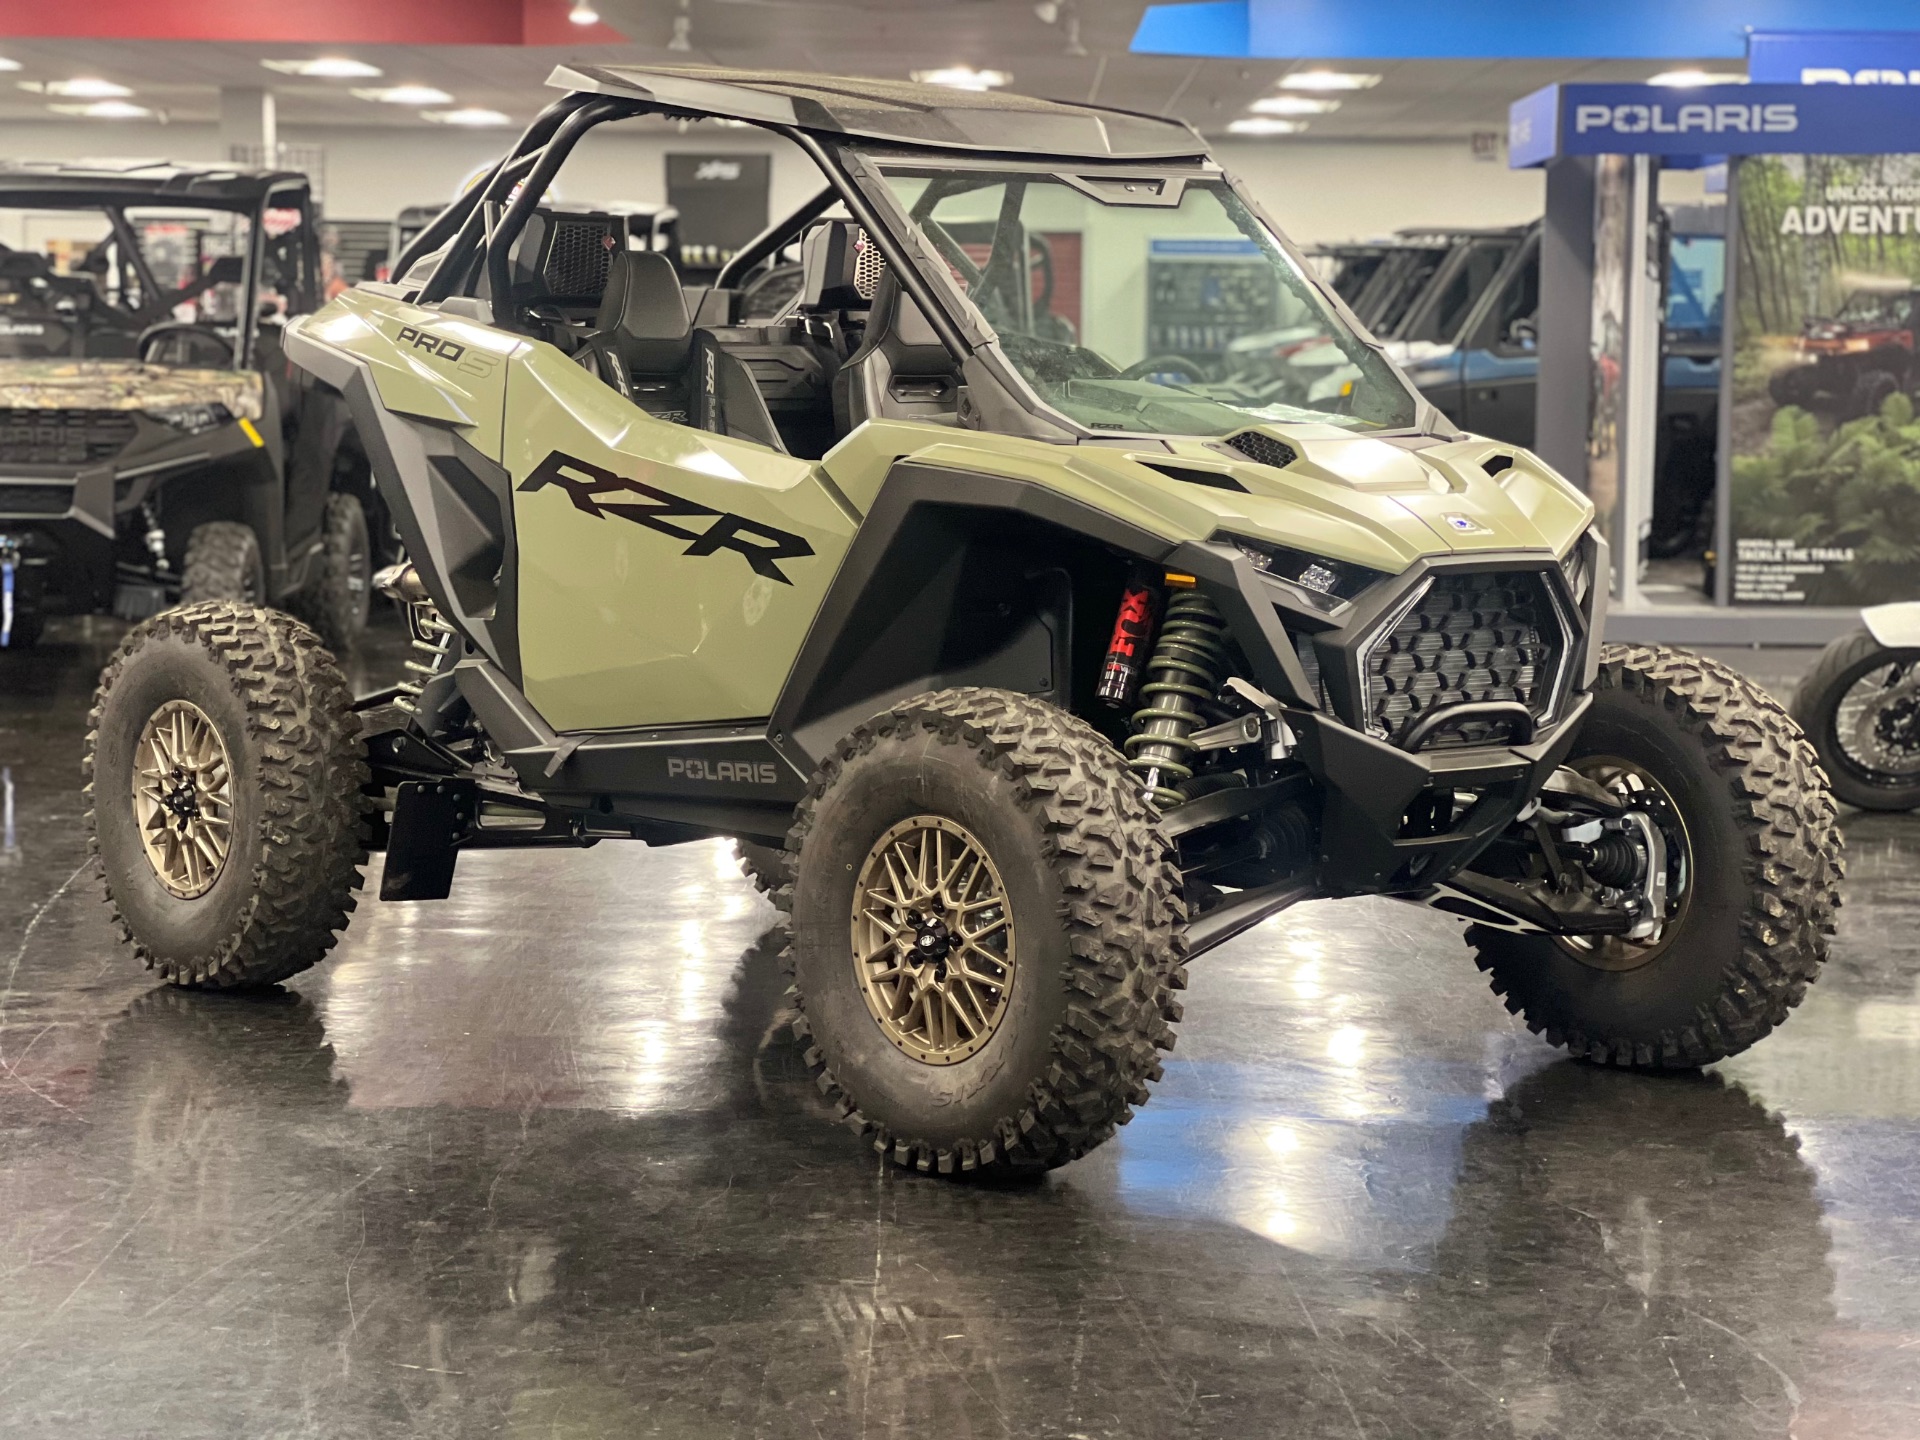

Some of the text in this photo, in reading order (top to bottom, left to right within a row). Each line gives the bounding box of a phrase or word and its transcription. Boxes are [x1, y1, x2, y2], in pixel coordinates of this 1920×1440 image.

[1576, 103, 1799, 133] POLARIS
[1825, 185, 1889, 202] UNLOCK
[396, 326, 466, 362] PRO
[705, 347, 715, 394] RZR
[515, 449, 816, 586] RZR
[1785, 548, 1809, 561] THE
[1811, 547, 1855, 561] TRAILS
[1109, 588, 1150, 657] FOX
[667, 757, 777, 784] POLARIS
